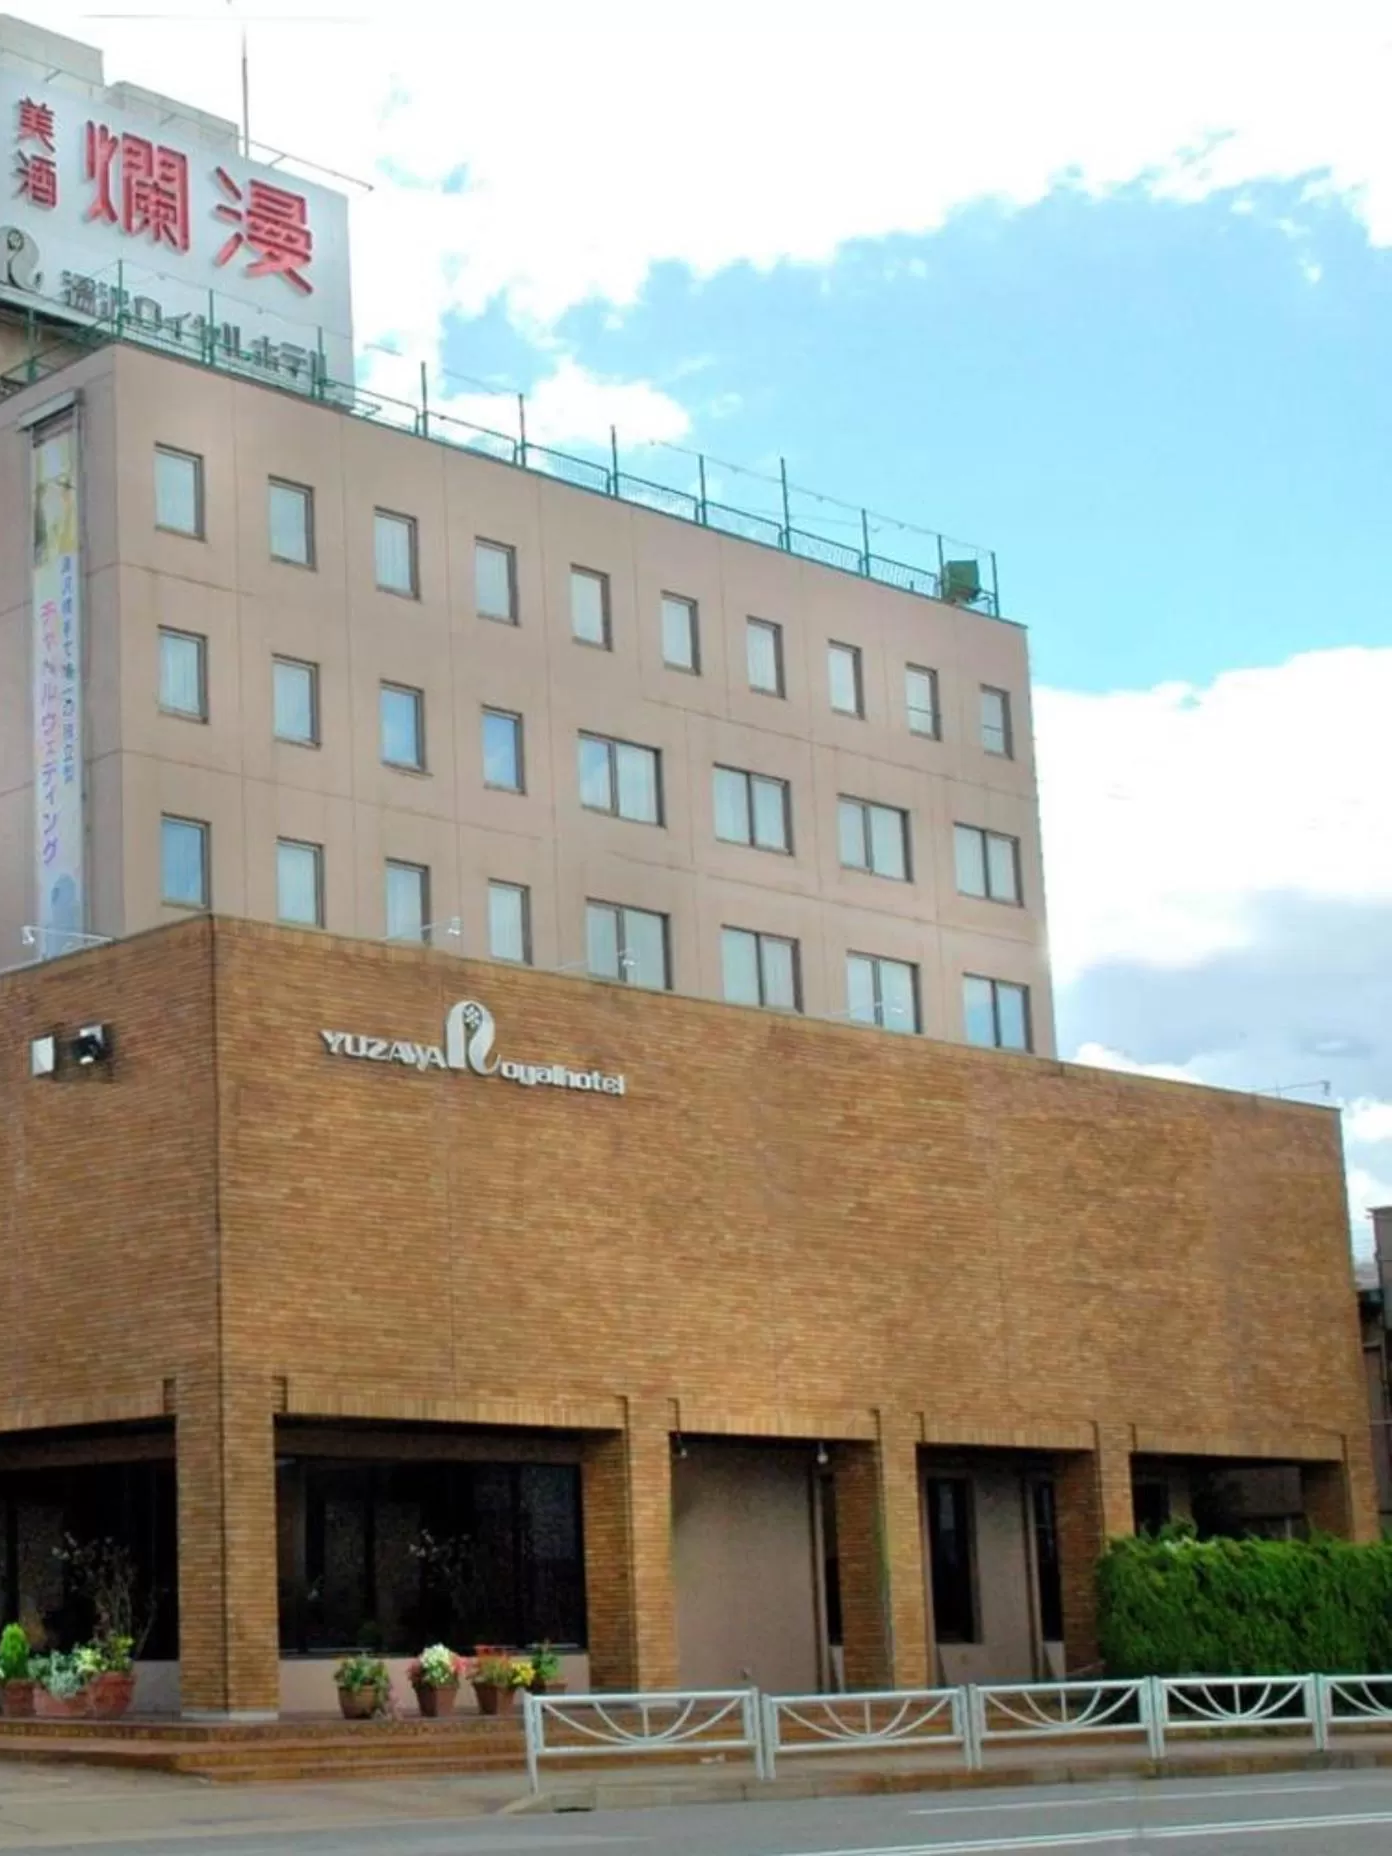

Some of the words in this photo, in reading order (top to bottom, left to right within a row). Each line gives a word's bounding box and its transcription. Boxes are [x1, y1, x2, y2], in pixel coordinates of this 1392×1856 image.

[15, 96, 59, 210] 美酒
[83, 120, 314, 295] 爛漫
[321, 1029, 448, 1071] YUZAWA
